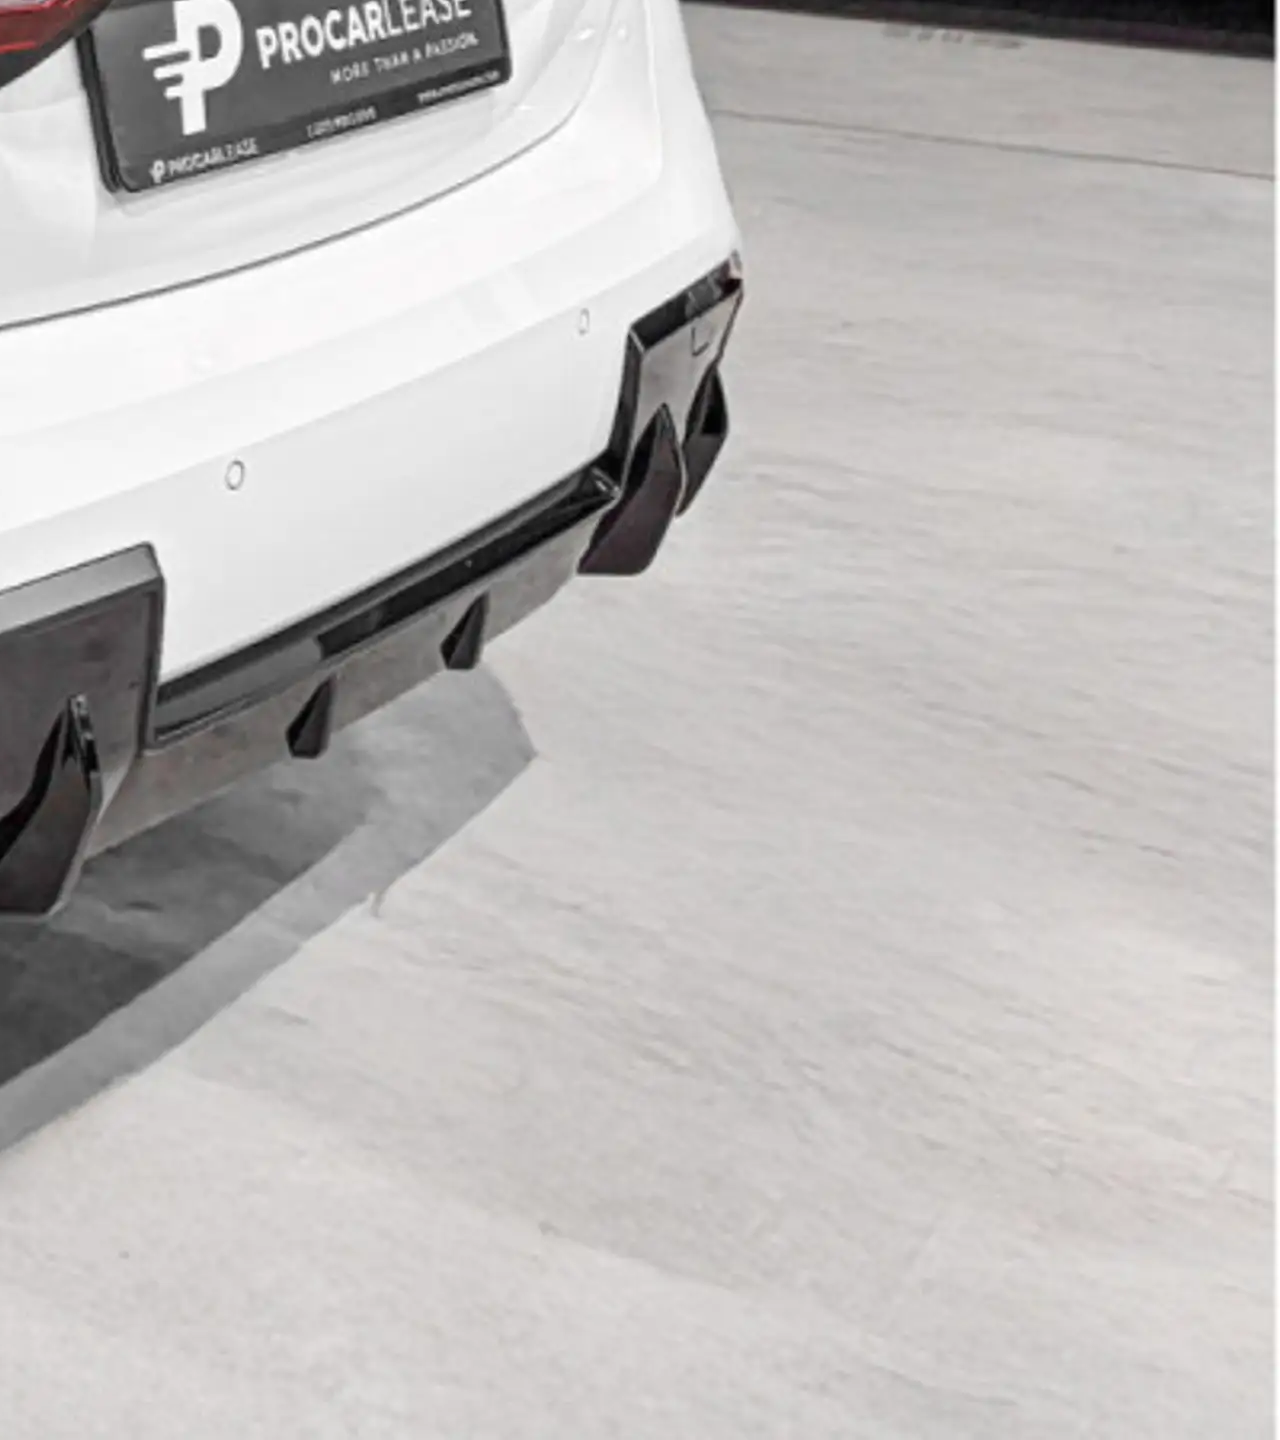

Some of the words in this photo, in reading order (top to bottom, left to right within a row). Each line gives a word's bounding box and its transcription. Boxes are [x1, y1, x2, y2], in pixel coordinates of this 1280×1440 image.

[329, 60, 370, 85] MORE
[373, 51, 410, 73] THAN
[412, 47, 422, 60] A
